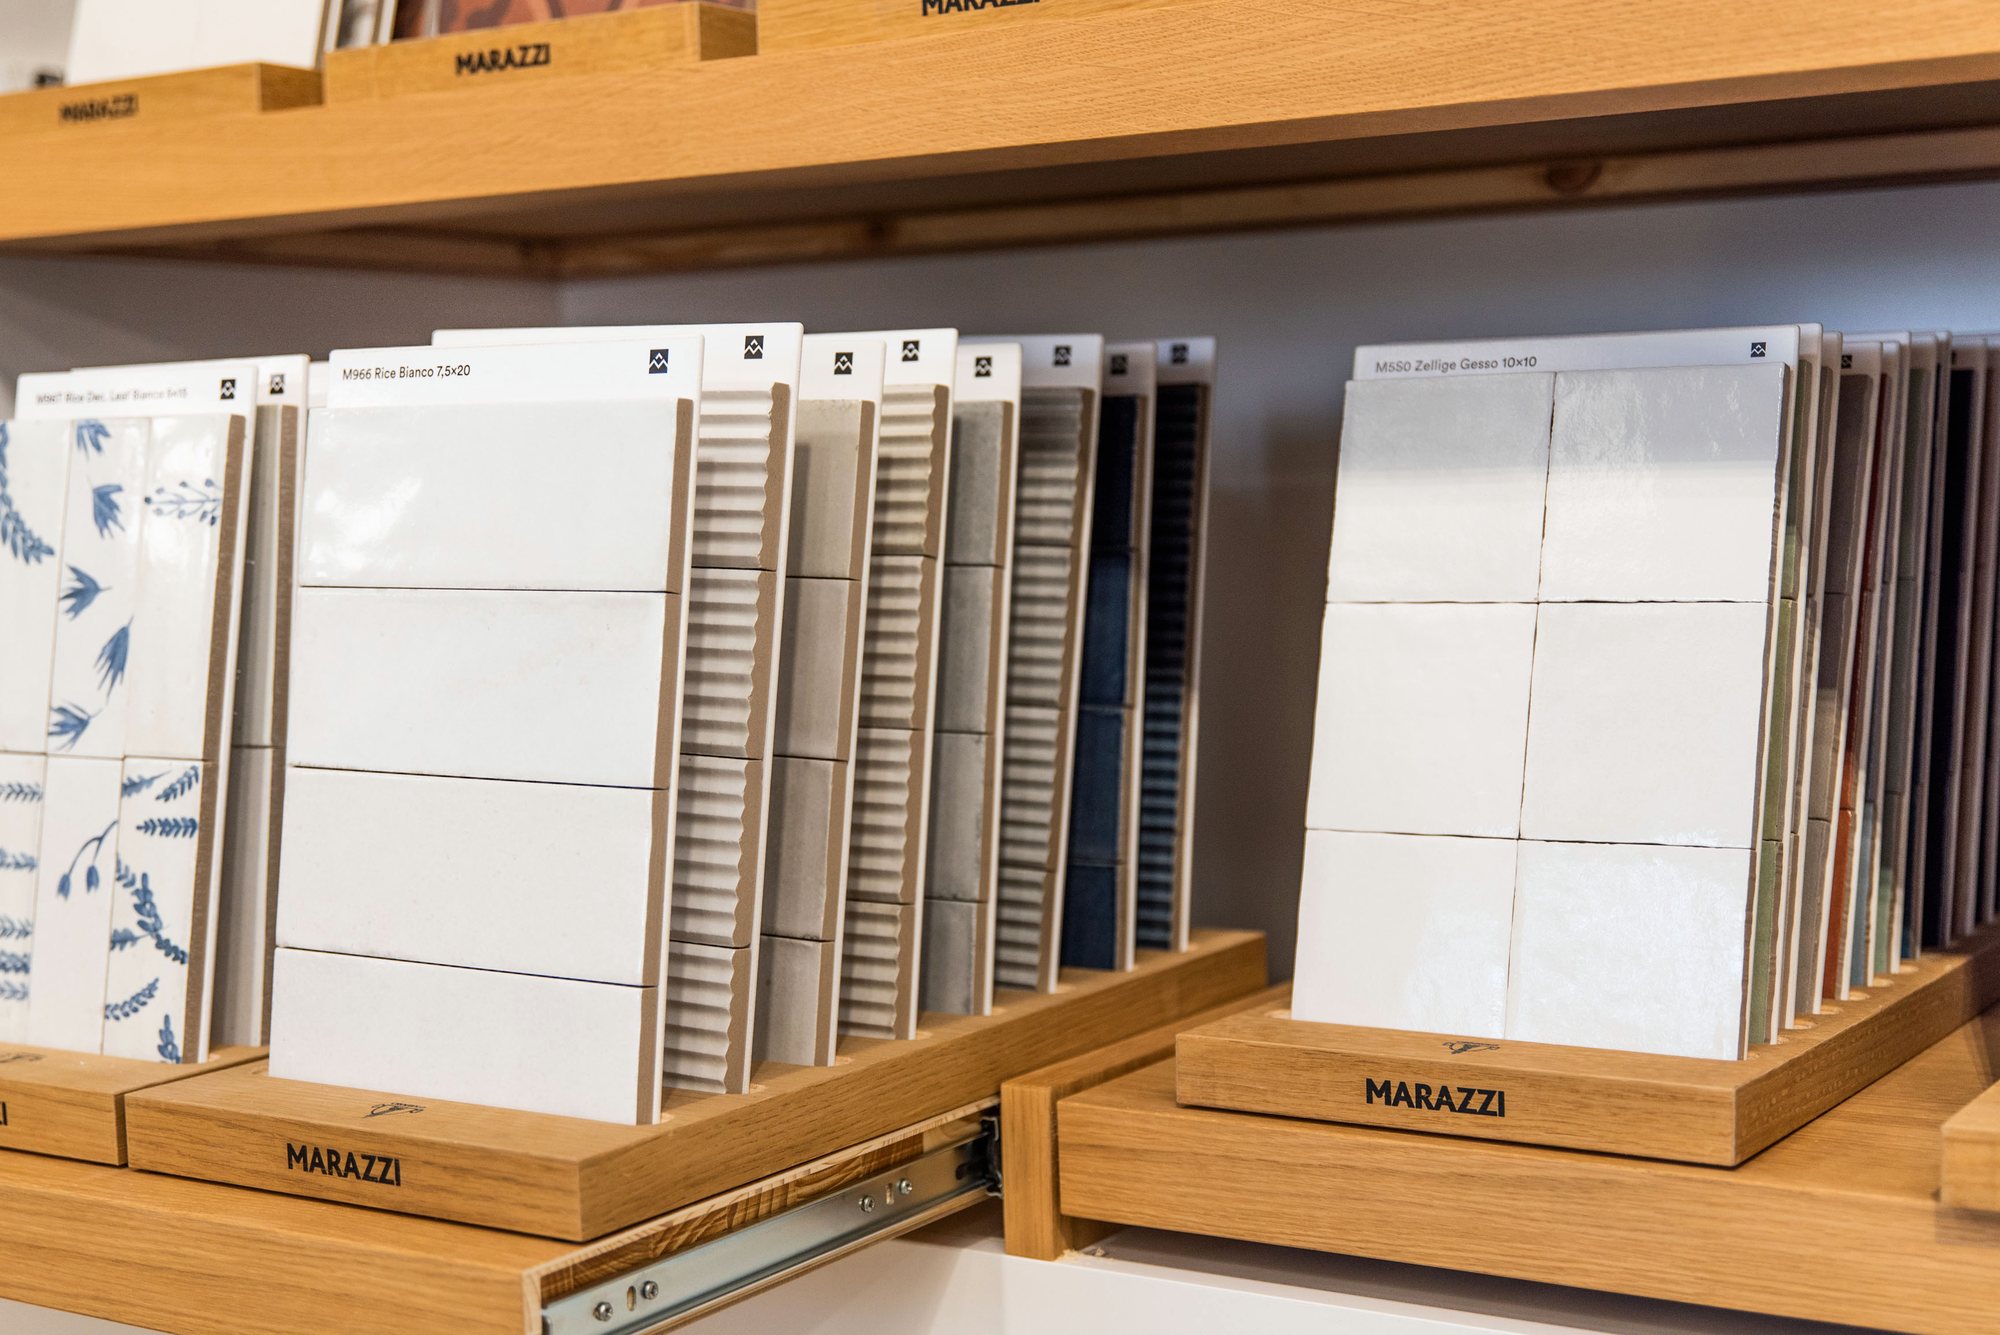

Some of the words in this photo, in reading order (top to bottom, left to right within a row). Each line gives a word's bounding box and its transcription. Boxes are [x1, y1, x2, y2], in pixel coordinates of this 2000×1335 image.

[455, 43, 550, 76] MARAZZI
[342, 368, 372, 380] M966
[374, 366, 396, 379] Rice
[399, 365, 434, 378] Bianco
[1415, 359, 1457, 373] Zellige
[1460, 357, 1498, 370] Gesso
[1365, 1077, 1506, 1118] MARAZZI
[286, 1142, 401, 1187] MARAZZI
